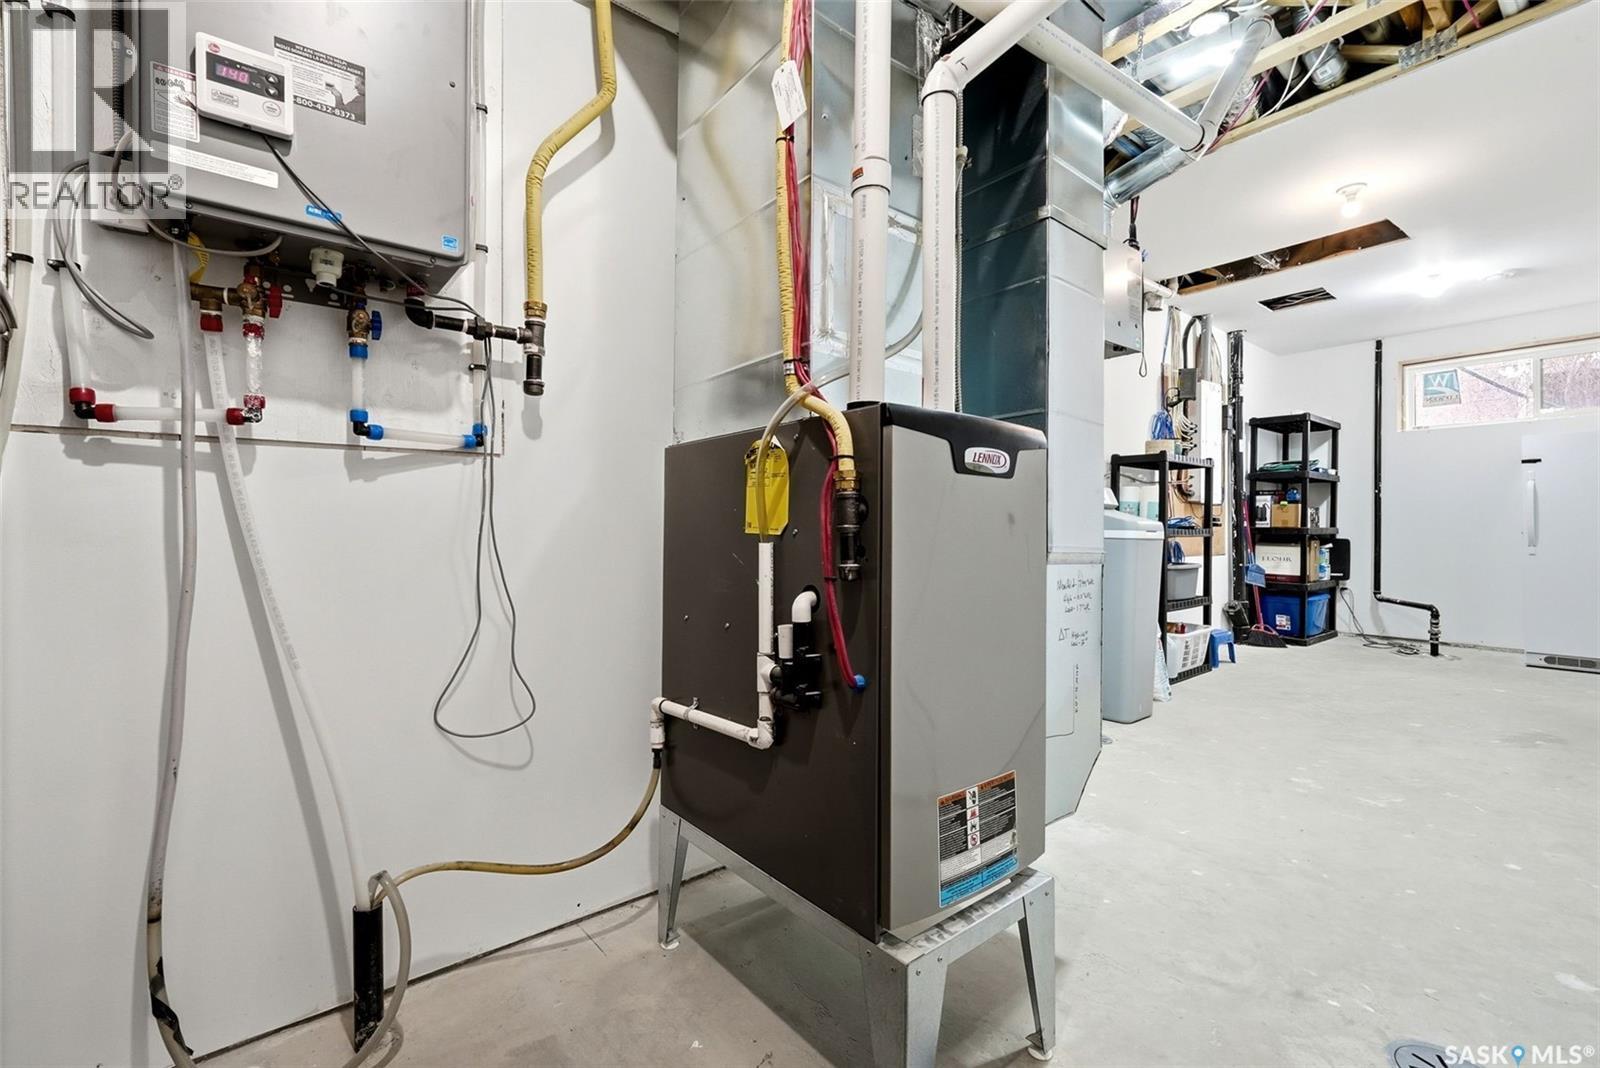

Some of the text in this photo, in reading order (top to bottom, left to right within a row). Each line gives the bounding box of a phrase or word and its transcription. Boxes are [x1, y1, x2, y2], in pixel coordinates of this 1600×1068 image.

[223, 66, 250, 85] 140
[294, 96, 356, 121] -800-432-8373
[972, 452, 1002, 466] LENNOX
